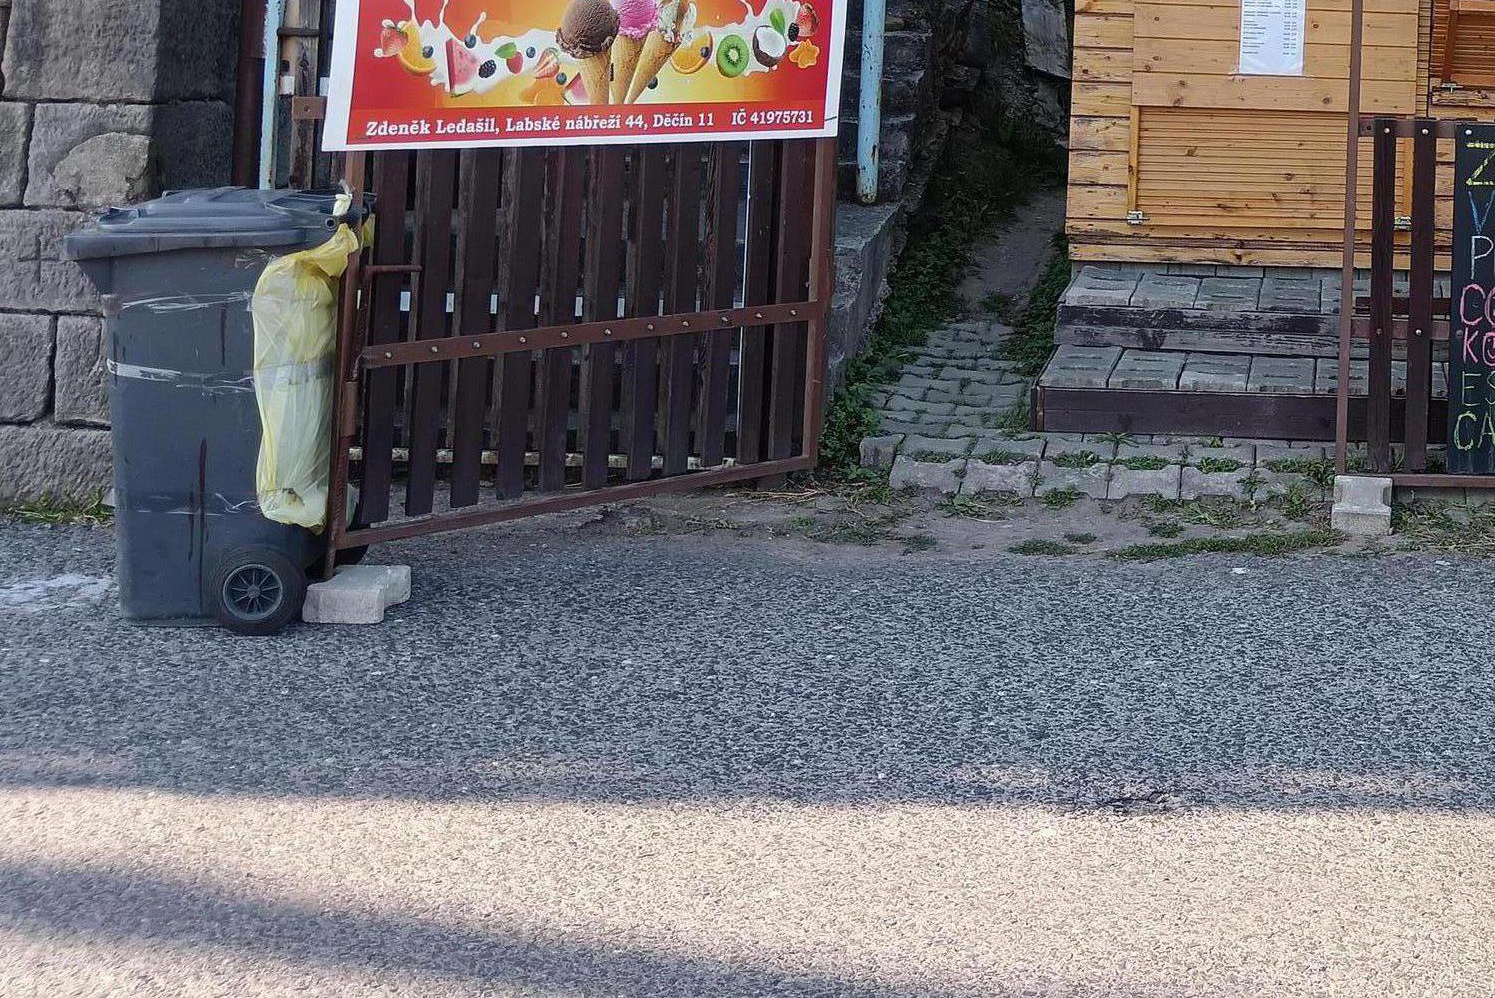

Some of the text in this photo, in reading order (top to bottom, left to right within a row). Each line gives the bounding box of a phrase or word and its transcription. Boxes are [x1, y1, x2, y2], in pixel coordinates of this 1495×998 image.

[365, 106, 814, 137] Zdeněk Ledašil, Labské nábřeží 44, Děčín 11 IČ 41975731
